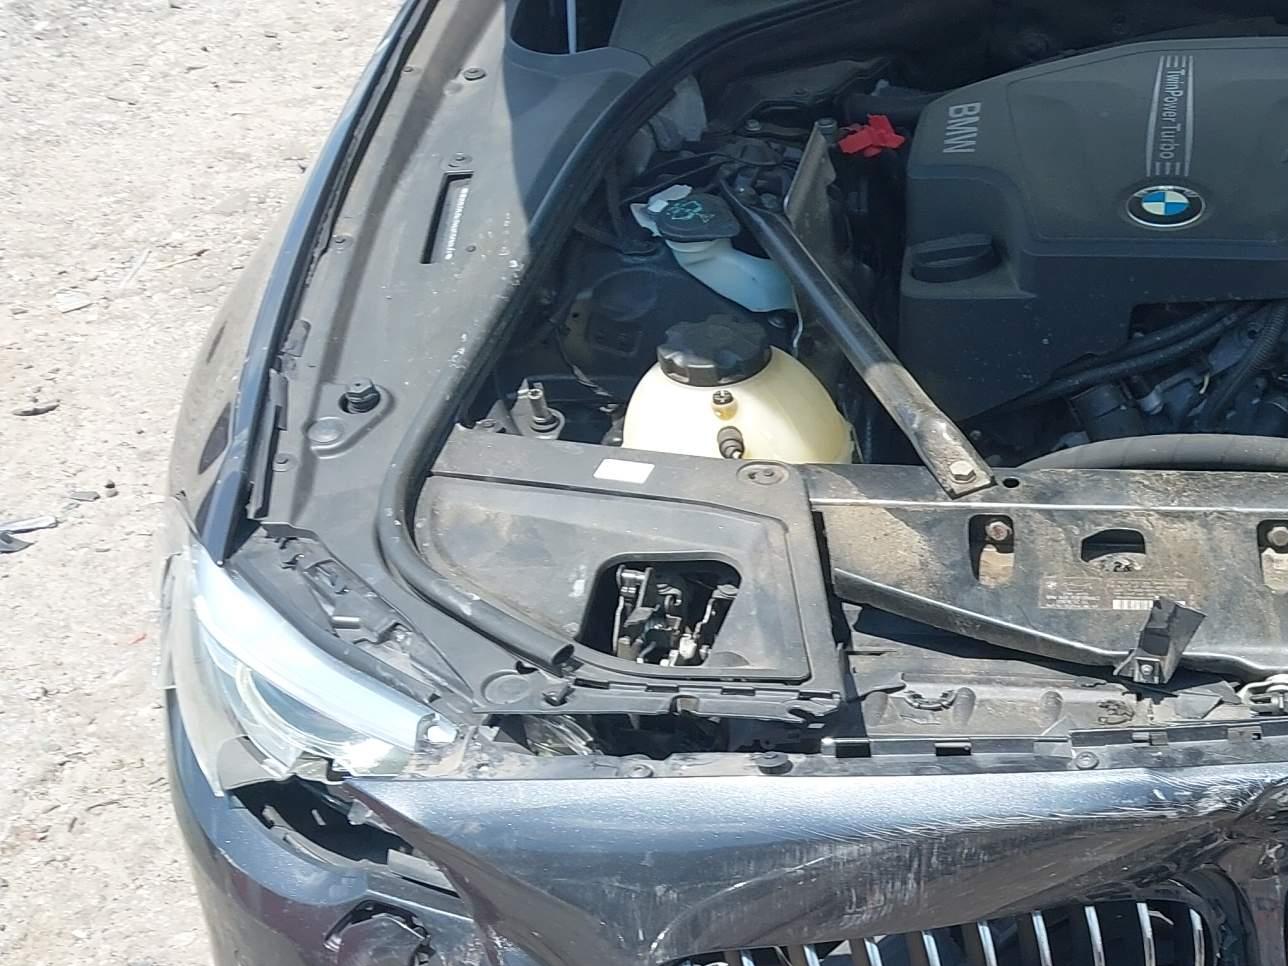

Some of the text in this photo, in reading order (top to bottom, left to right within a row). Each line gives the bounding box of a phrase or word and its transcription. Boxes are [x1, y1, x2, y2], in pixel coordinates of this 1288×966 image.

[943, 102, 981, 153] BMW
[1160, 68, 1186, 159] TwinPower Turbo
